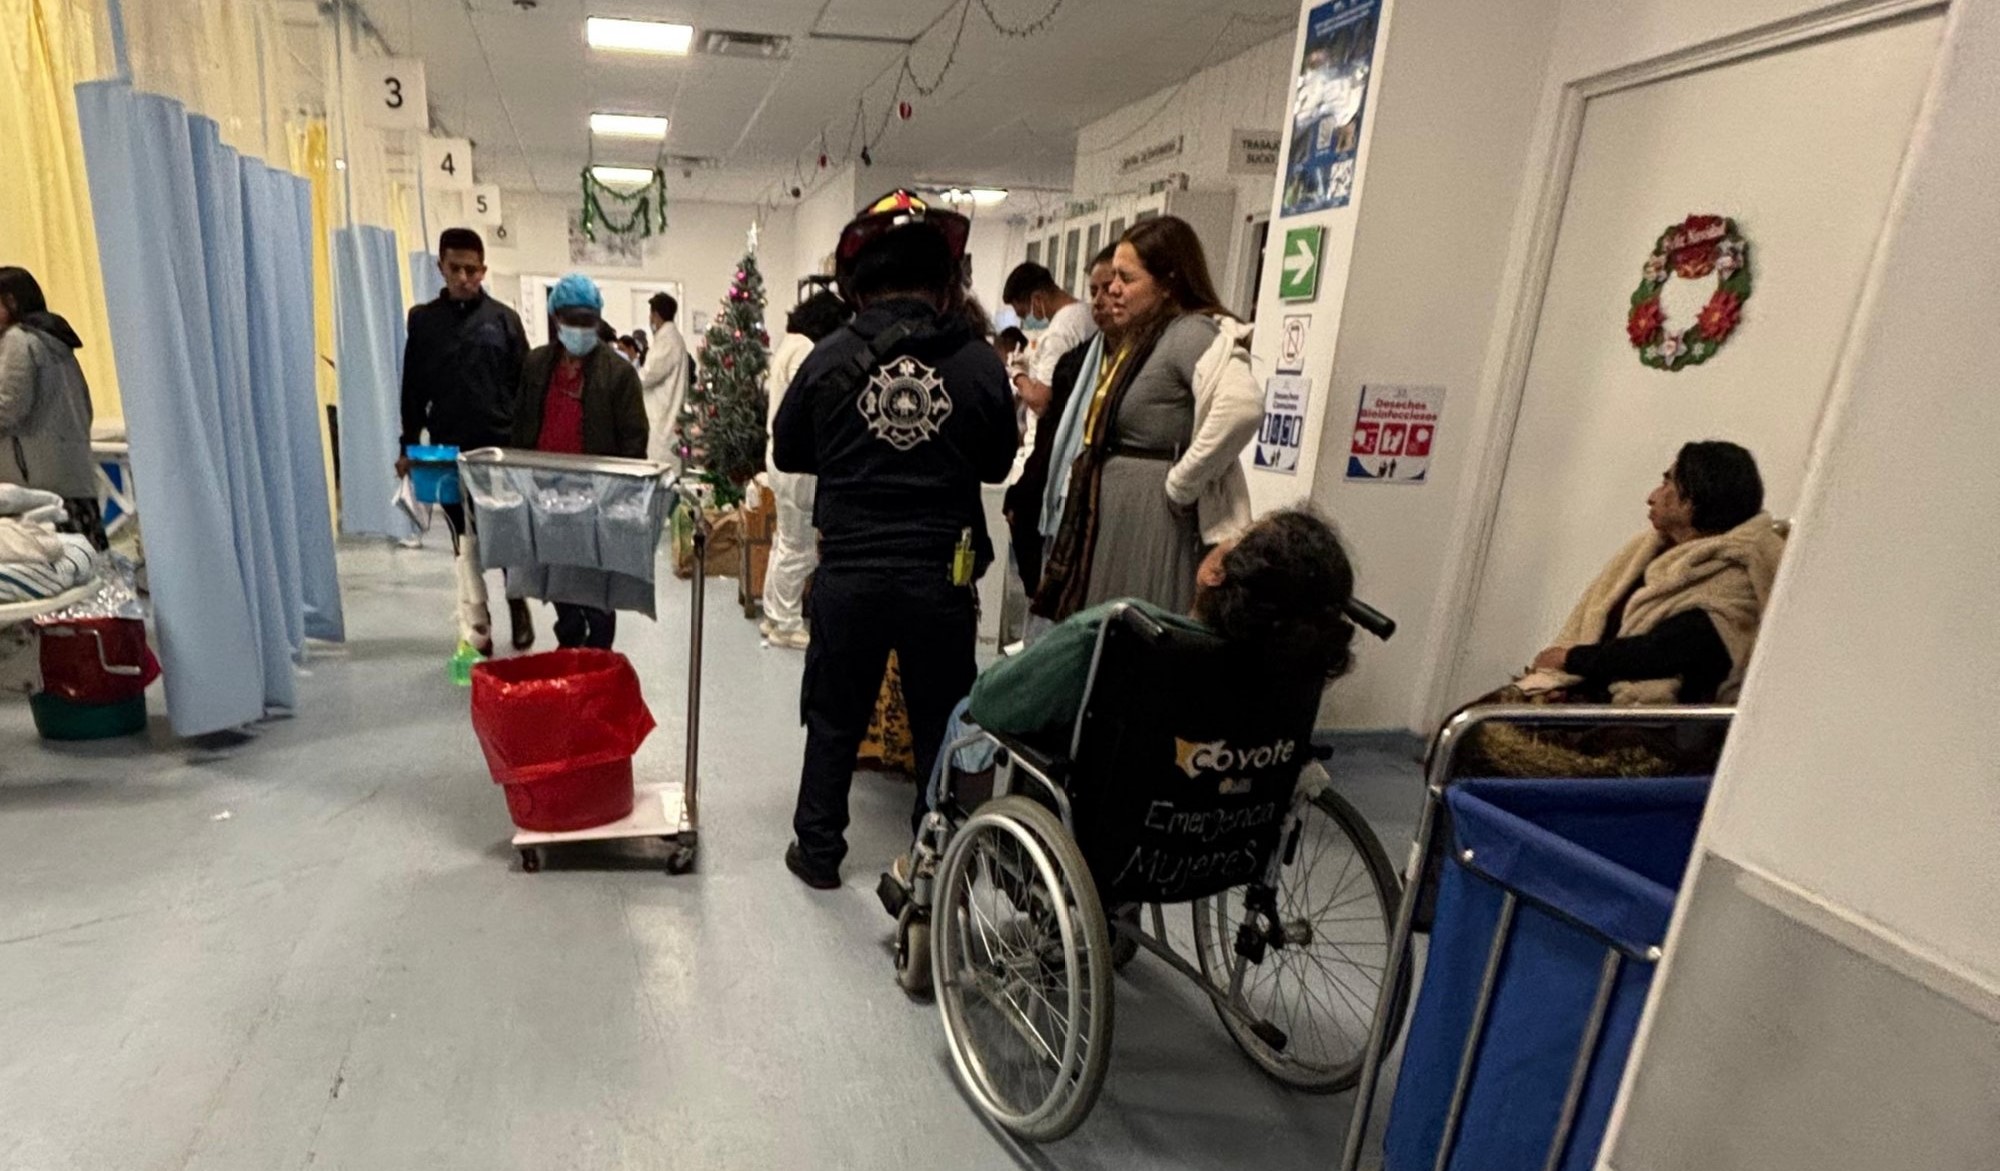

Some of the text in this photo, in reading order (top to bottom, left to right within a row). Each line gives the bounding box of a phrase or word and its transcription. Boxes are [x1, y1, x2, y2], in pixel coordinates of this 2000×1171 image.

[384, 77, 403, 109] 3
[441, 153, 455, 175] 4
[477, 196, 488, 213] 5
[497, 225, 507, 239] 6
[1376, 398, 1427, 410] Desechos
